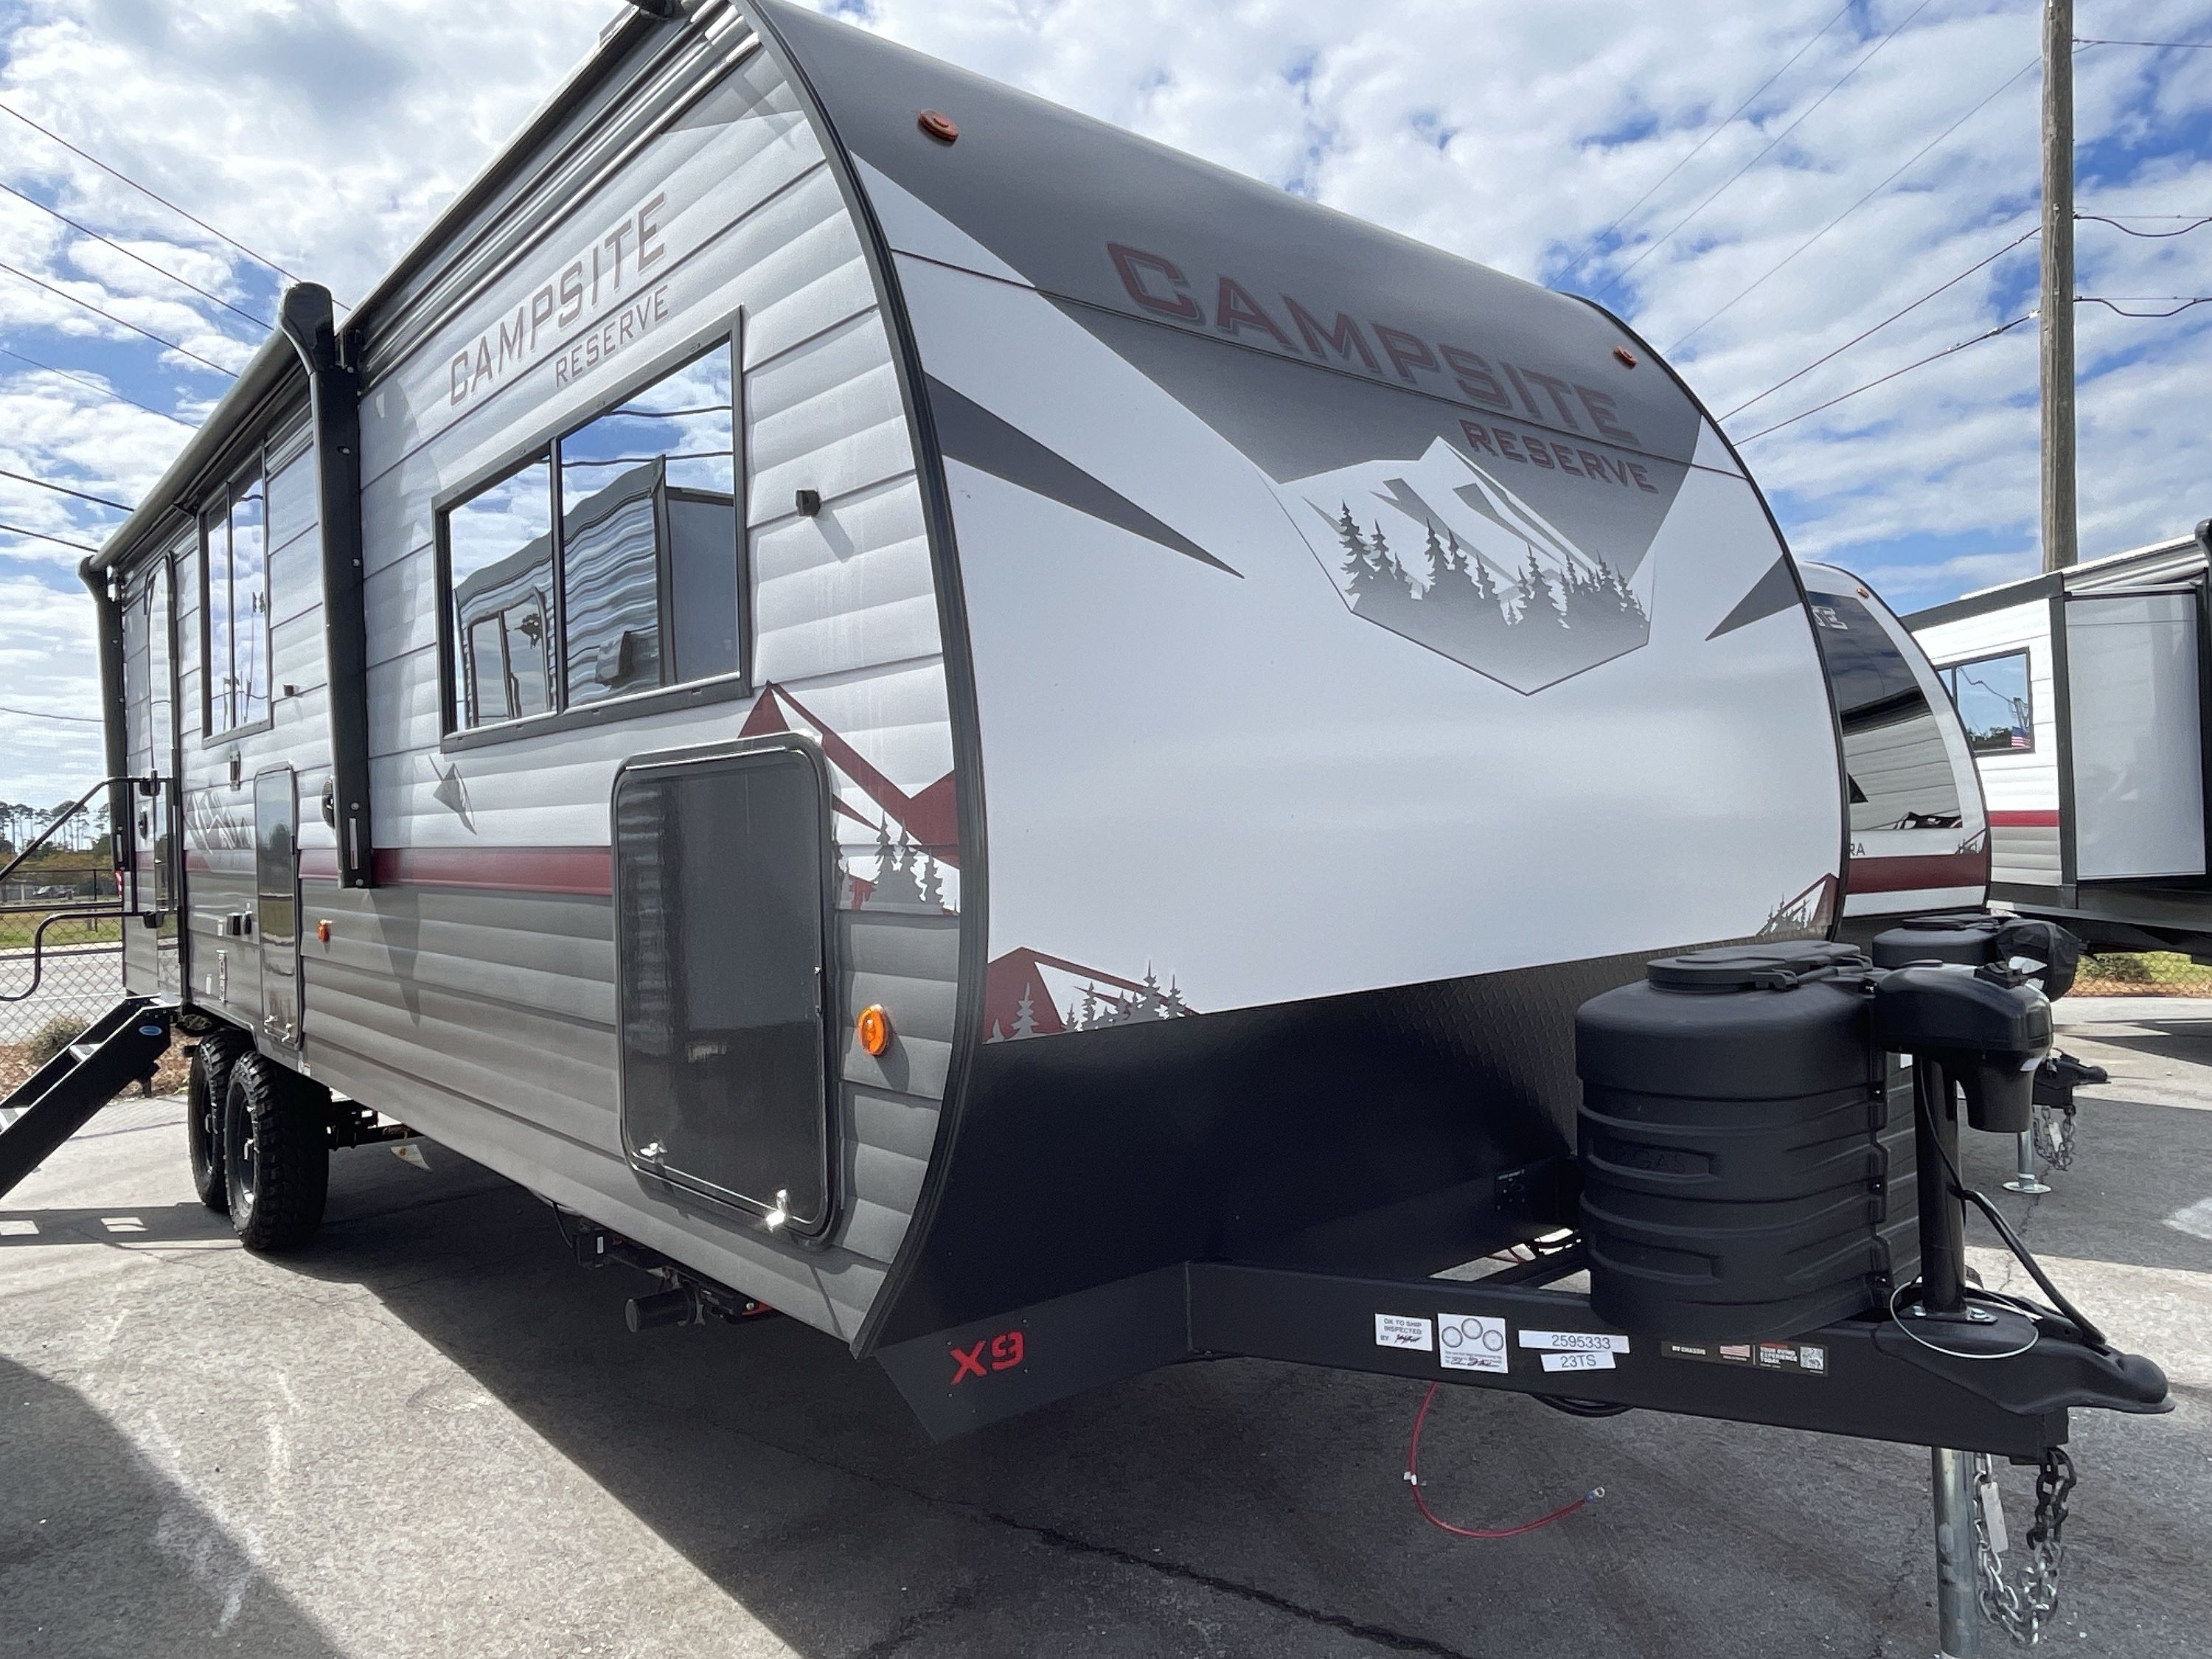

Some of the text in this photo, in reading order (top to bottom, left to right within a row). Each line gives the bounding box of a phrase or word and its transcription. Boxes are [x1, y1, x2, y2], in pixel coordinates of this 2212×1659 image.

[450, 191, 666, 407] CAMPSITE
[555, 285, 669, 389] RESERVE
[1107, 240, 1639, 443] CAMPSITE
[1458, 418, 1660, 494] RESERVE
[950, 1331, 1025, 1386] X9
[1551, 1334, 1611, 1349] 2595333
[1560, 1354, 1597, 1368] 23TS
